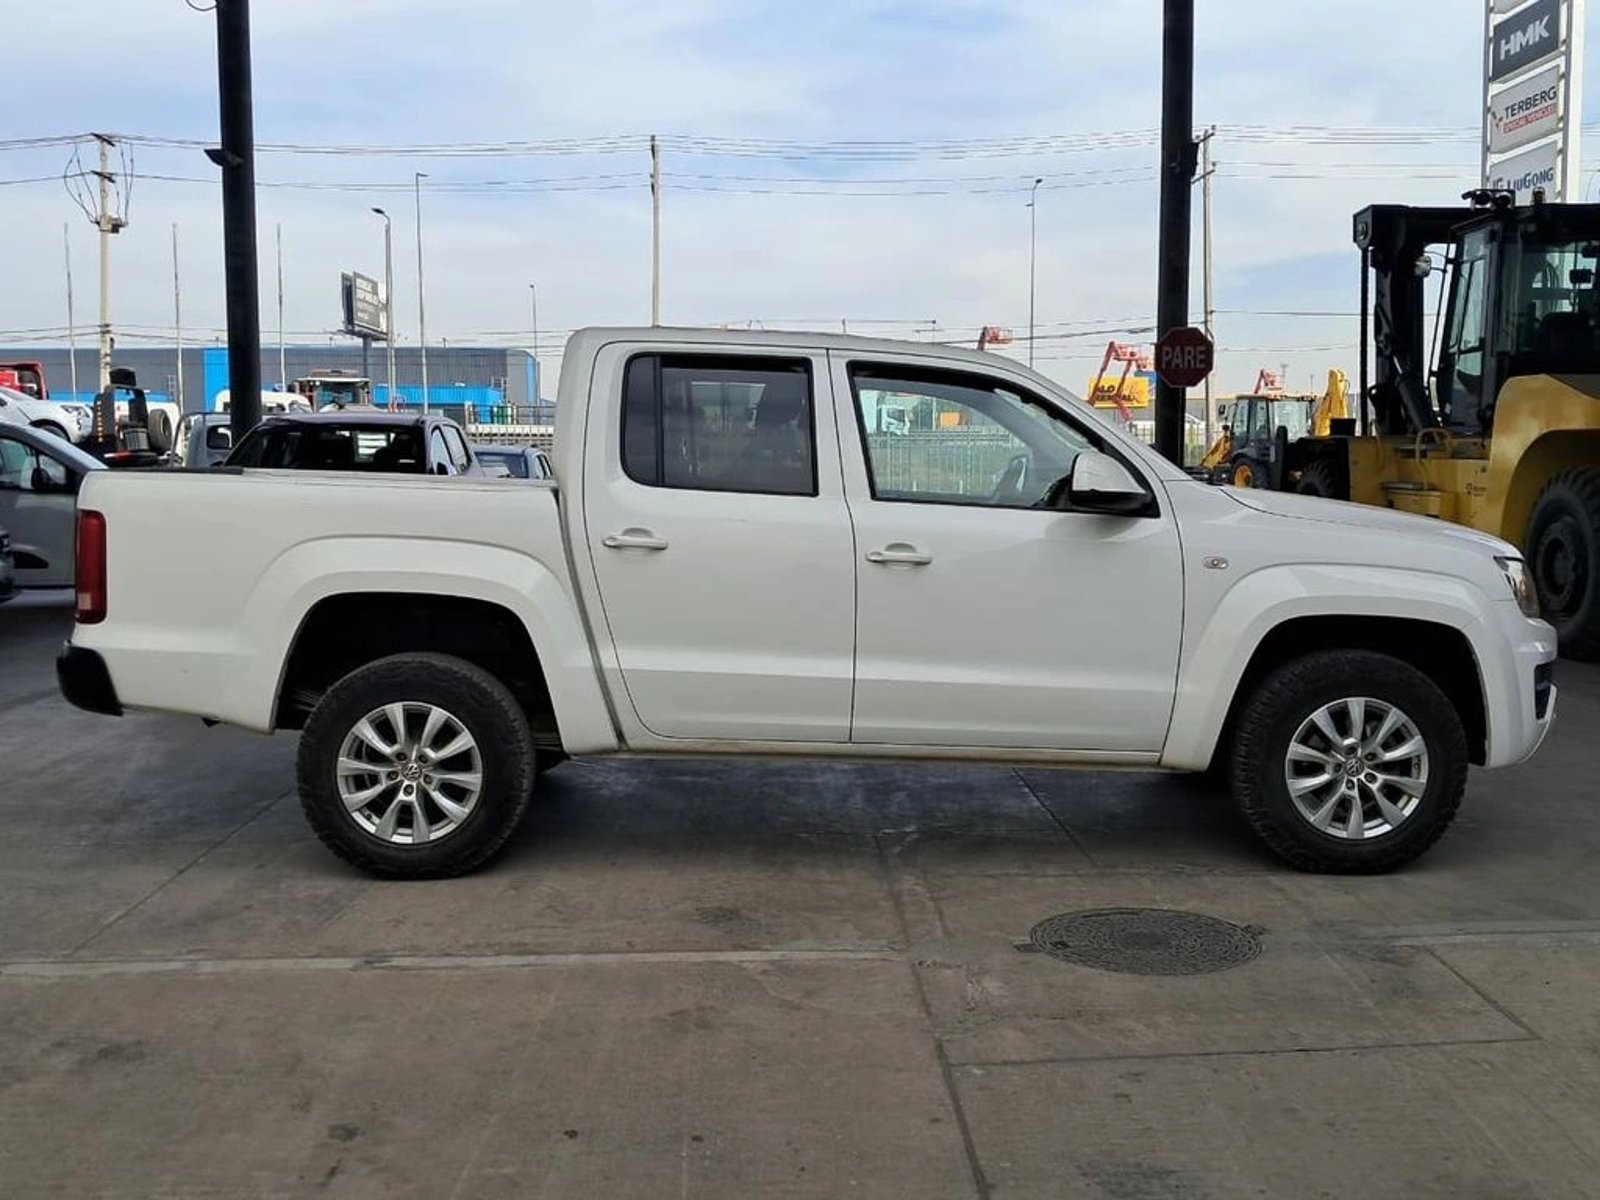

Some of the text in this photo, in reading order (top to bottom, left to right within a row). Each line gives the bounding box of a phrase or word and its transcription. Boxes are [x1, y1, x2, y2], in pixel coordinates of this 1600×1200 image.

[1501, 15, 1550, 60] HMK
[1504, 86, 1557, 119] TERBERG
[1162, 346, 1206, 368] PARE
